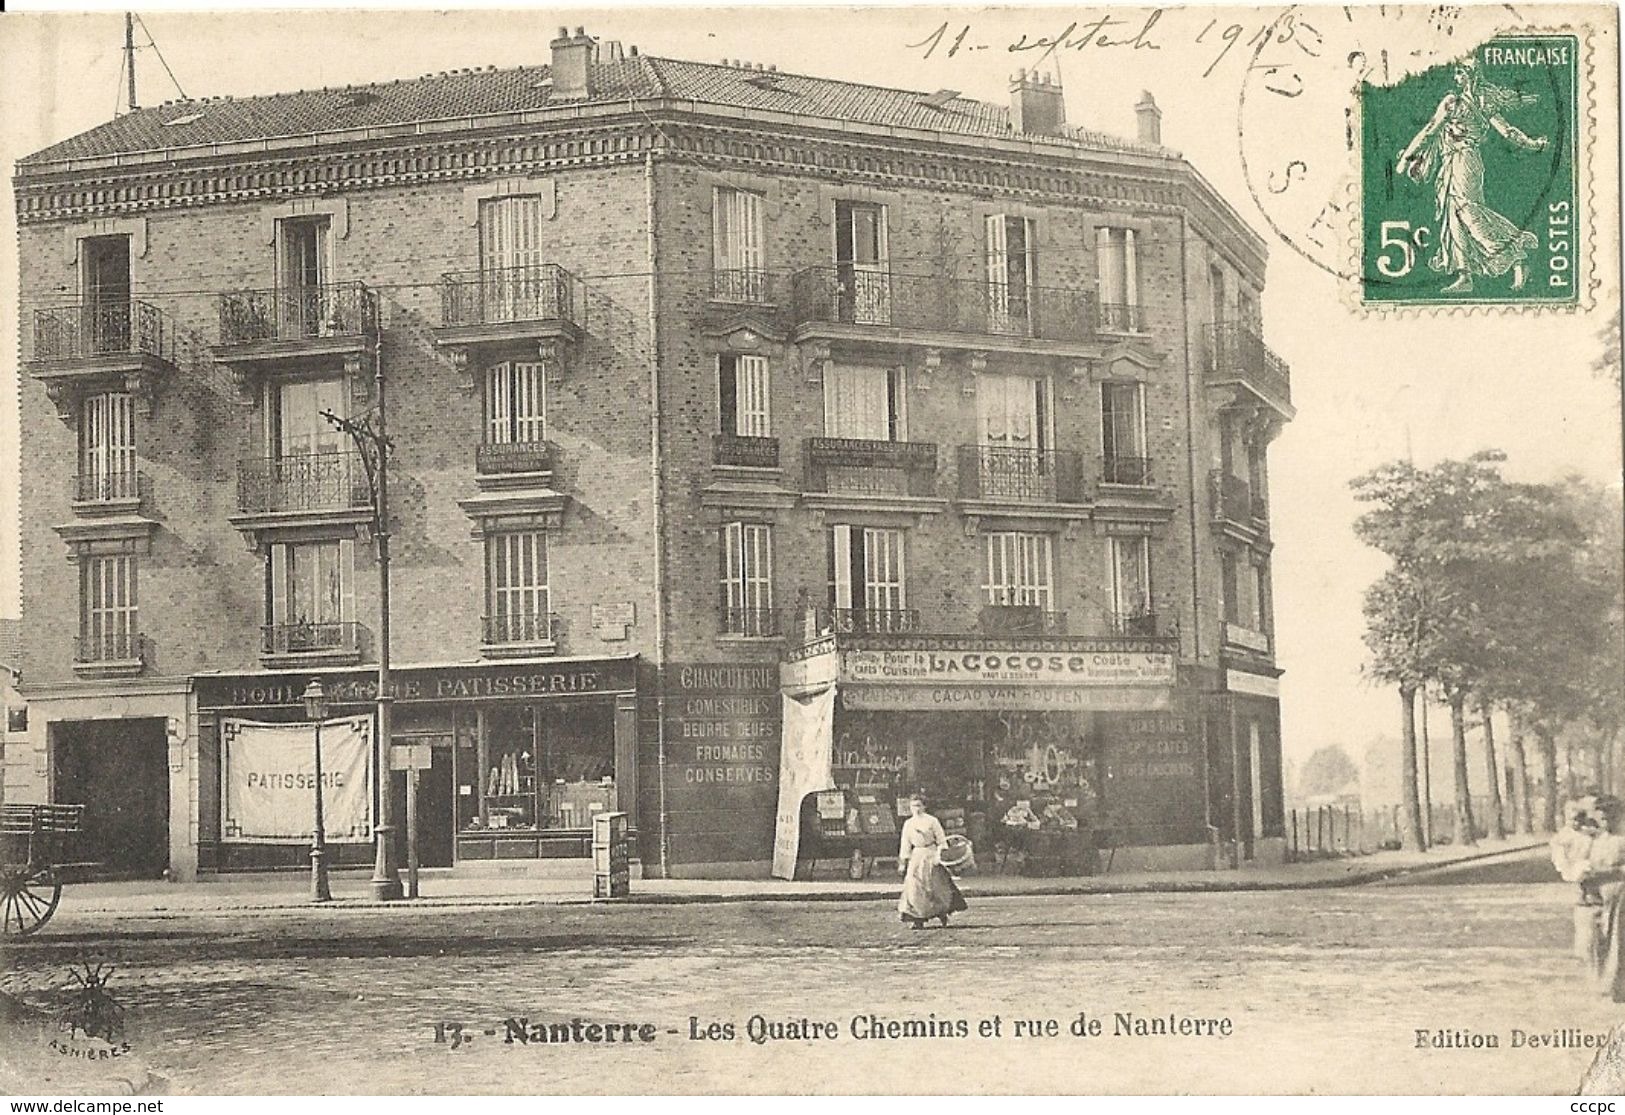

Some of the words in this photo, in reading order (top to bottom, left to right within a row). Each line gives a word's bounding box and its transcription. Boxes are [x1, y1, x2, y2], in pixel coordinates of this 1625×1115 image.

[1485, 47, 1569, 66] FRANÇAISE
[1550, 201, 1569, 287] POSTES
[479, 442, 547, 455] ASSURANCES
[884, 652, 911, 665] Pour
[681, 666, 774, 689] CHARCUTERIE
[882, 665, 927, 677] Cuisine
[437, 672, 600, 697] PATISSERIE
[932, 689, 982, 704] CACAO
[988, 688, 1016, 700] VAN
[687, 698, 770, 715] COMESTIBLES
[683, 722, 731, 738] BEURRE
[696, 745, 763, 761] FROMAGES
[247, 771, 345, 789] PATISSERIE
[685, 766, 773, 783] CONSERVES
[502, 1016, 656, 1044] Nanterre
[688, 1016, 735, 1041] Les
[747, 1014, 839, 1043] Quatre
[850, 1013, 969, 1040] Chemins
[978, 1017, 1003, 1038] et
[1013, 1018, 1059, 1038] rue
[1070, 1013, 1102, 1037] de
[1113, 1012, 1234, 1037] Nanterre
[1414, 1028, 1500, 1048] Edition
